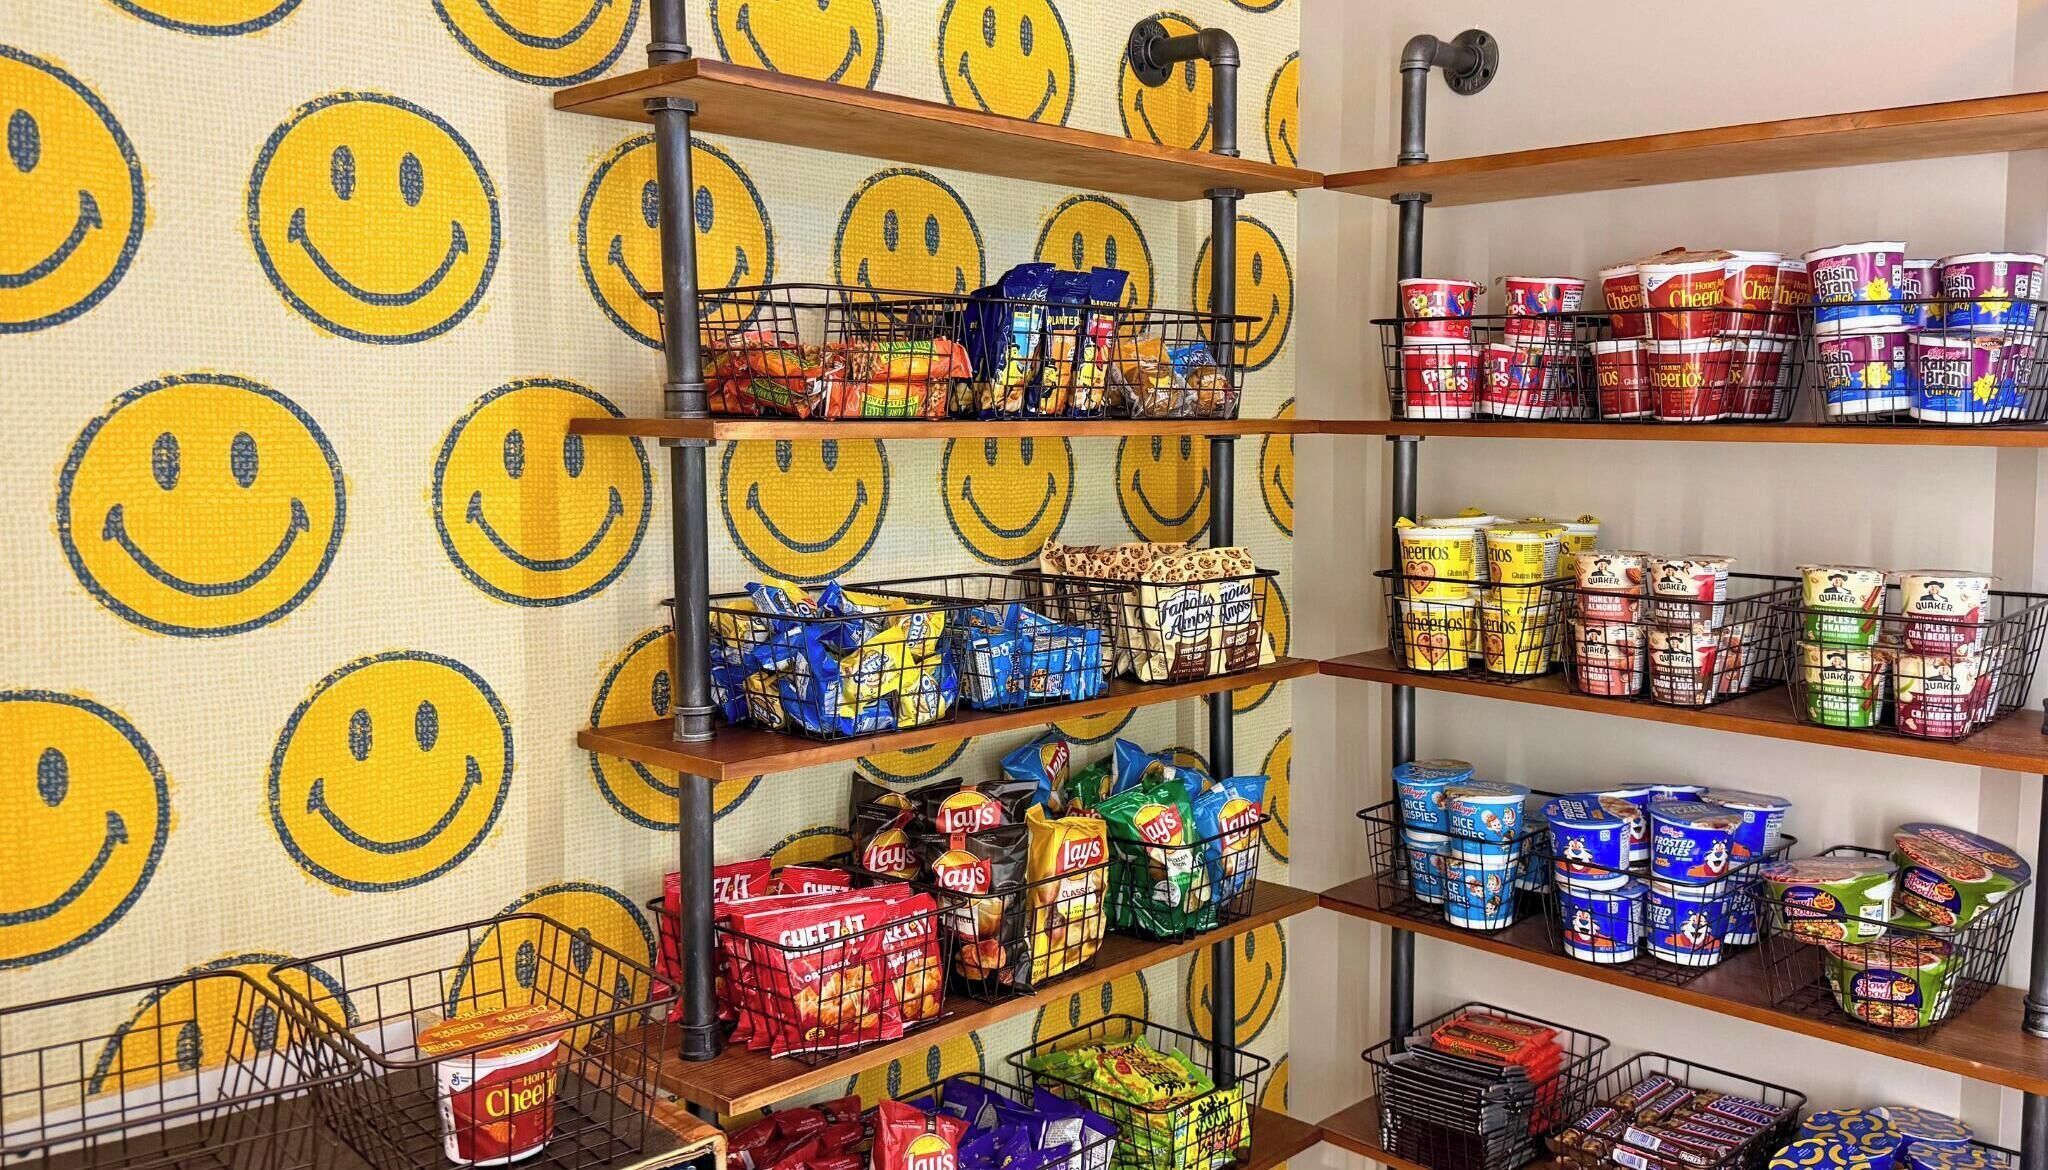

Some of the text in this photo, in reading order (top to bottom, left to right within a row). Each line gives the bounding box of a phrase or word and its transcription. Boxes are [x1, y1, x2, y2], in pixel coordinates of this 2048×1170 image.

[1814, 267, 1856, 285] Raisin
[1944, 275, 1975, 289] aisin
[1818, 281, 1852, 298] Bran
[1921, 357, 1968, 375] Raisin
[1926, 371, 1963, 387] Bran
[1402, 546, 1449, 560] heerios
[1587, 577, 1620, 585] QUAKER
[1658, 583, 1688, 592] QUAKER
[1818, 593, 1856, 604] QUAKER
[1156, 593, 1215, 626] Famous
[1588, 603, 1622, 612] ALMONDS
[1915, 601, 1953, 612] QUAKER
[1165, 609, 1215, 640] Amos
[1406, 612, 1462, 632] Cheerios
[1816, 623, 1859, 633] CNNAMON
[1816, 701, 1860, 711] CNNAMON
[1405, 799, 1426, 812] RICE
[944, 803, 994, 833] Lay's
[1452, 815, 1474, 828] RICE
[1139, 810, 1177, 846] Lay's
[1654, 836, 1695, 848] FROSTED
[1063, 837, 1101, 872] Lay's
[1656, 845, 1690, 857] FLAKES
[1411, 862, 1425, 872] ICE
[937, 862, 986, 894] Lay's
[1908, 873, 1936, 890] Bowl
[1711, 1100, 1772, 1125] SNICKERS
